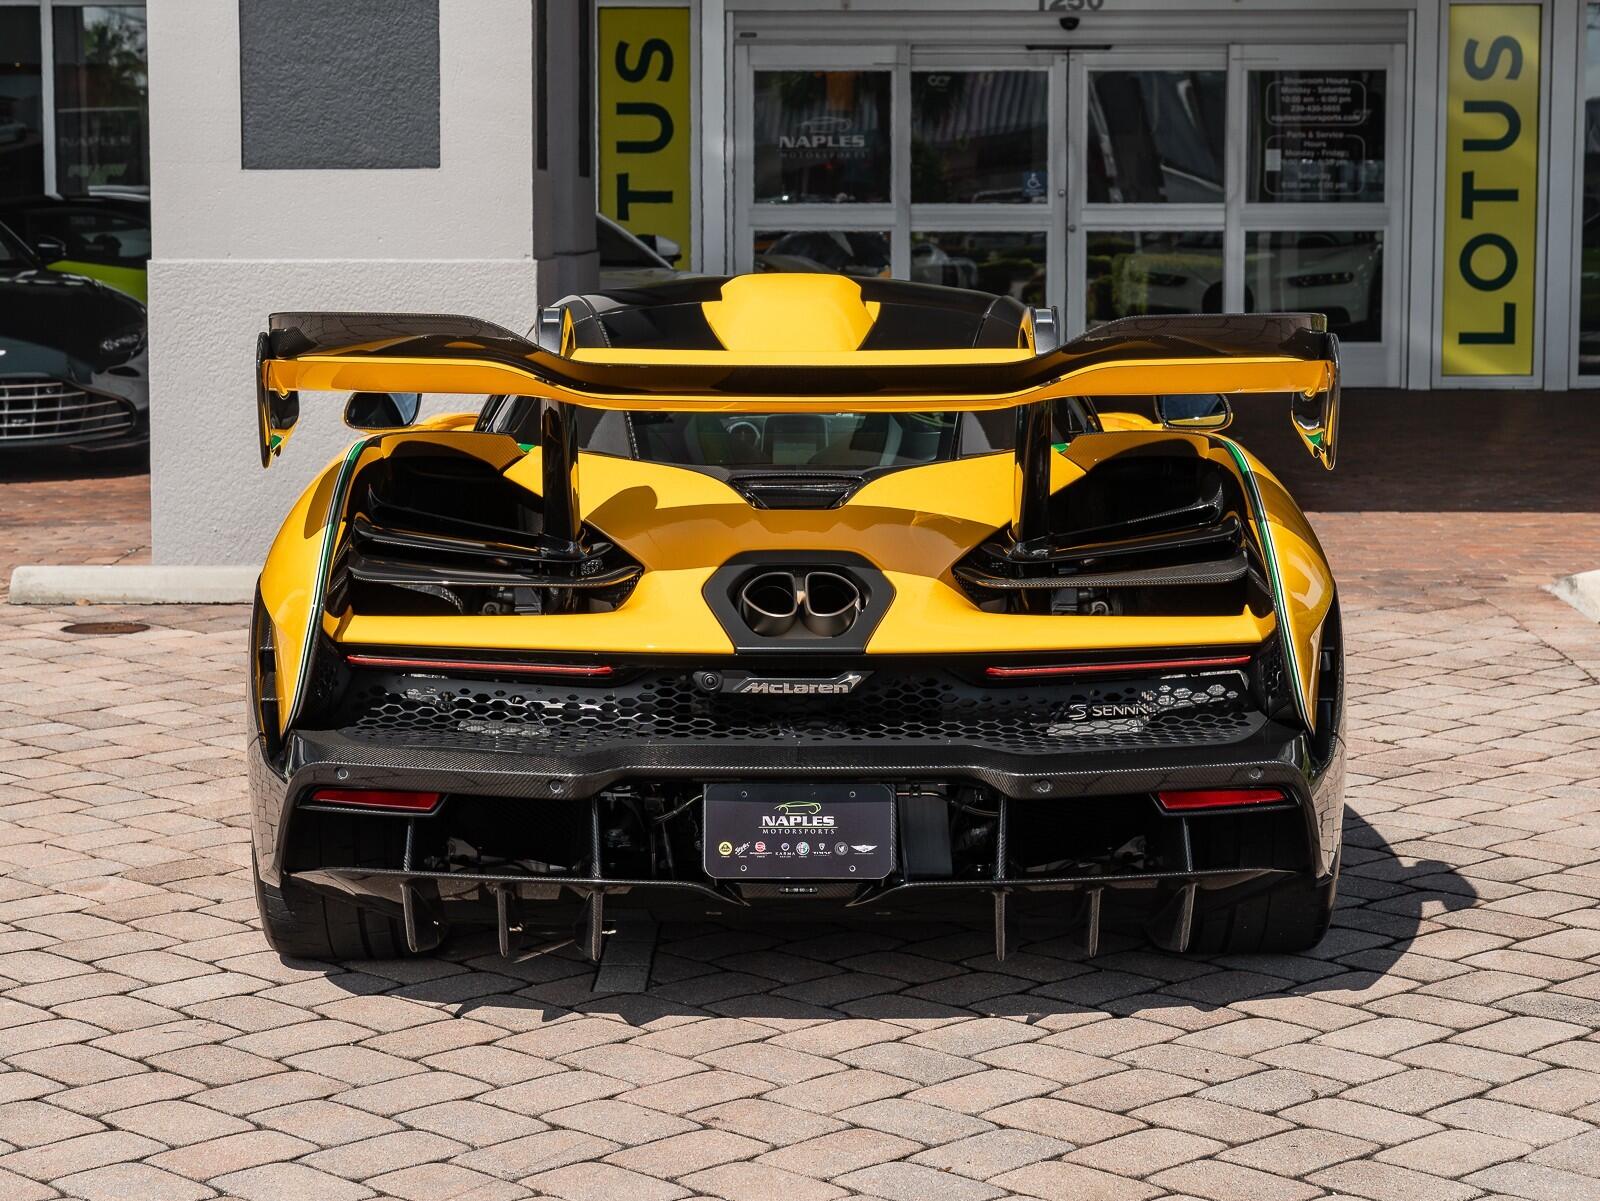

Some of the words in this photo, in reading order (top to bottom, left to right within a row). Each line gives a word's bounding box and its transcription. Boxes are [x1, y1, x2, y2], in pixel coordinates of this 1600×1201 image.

[1281, 86, 1311, 95] Monday
[1318, 86, 1351, 95] Saturday
[615, 38, 674, 222] TUS
[779, 135, 865, 148] NAPLES
[1458, 36, 1523, 345] LOTUS
[741, 682, 849, 694] McLaren
[762, 816, 835, 826] NAPLES
